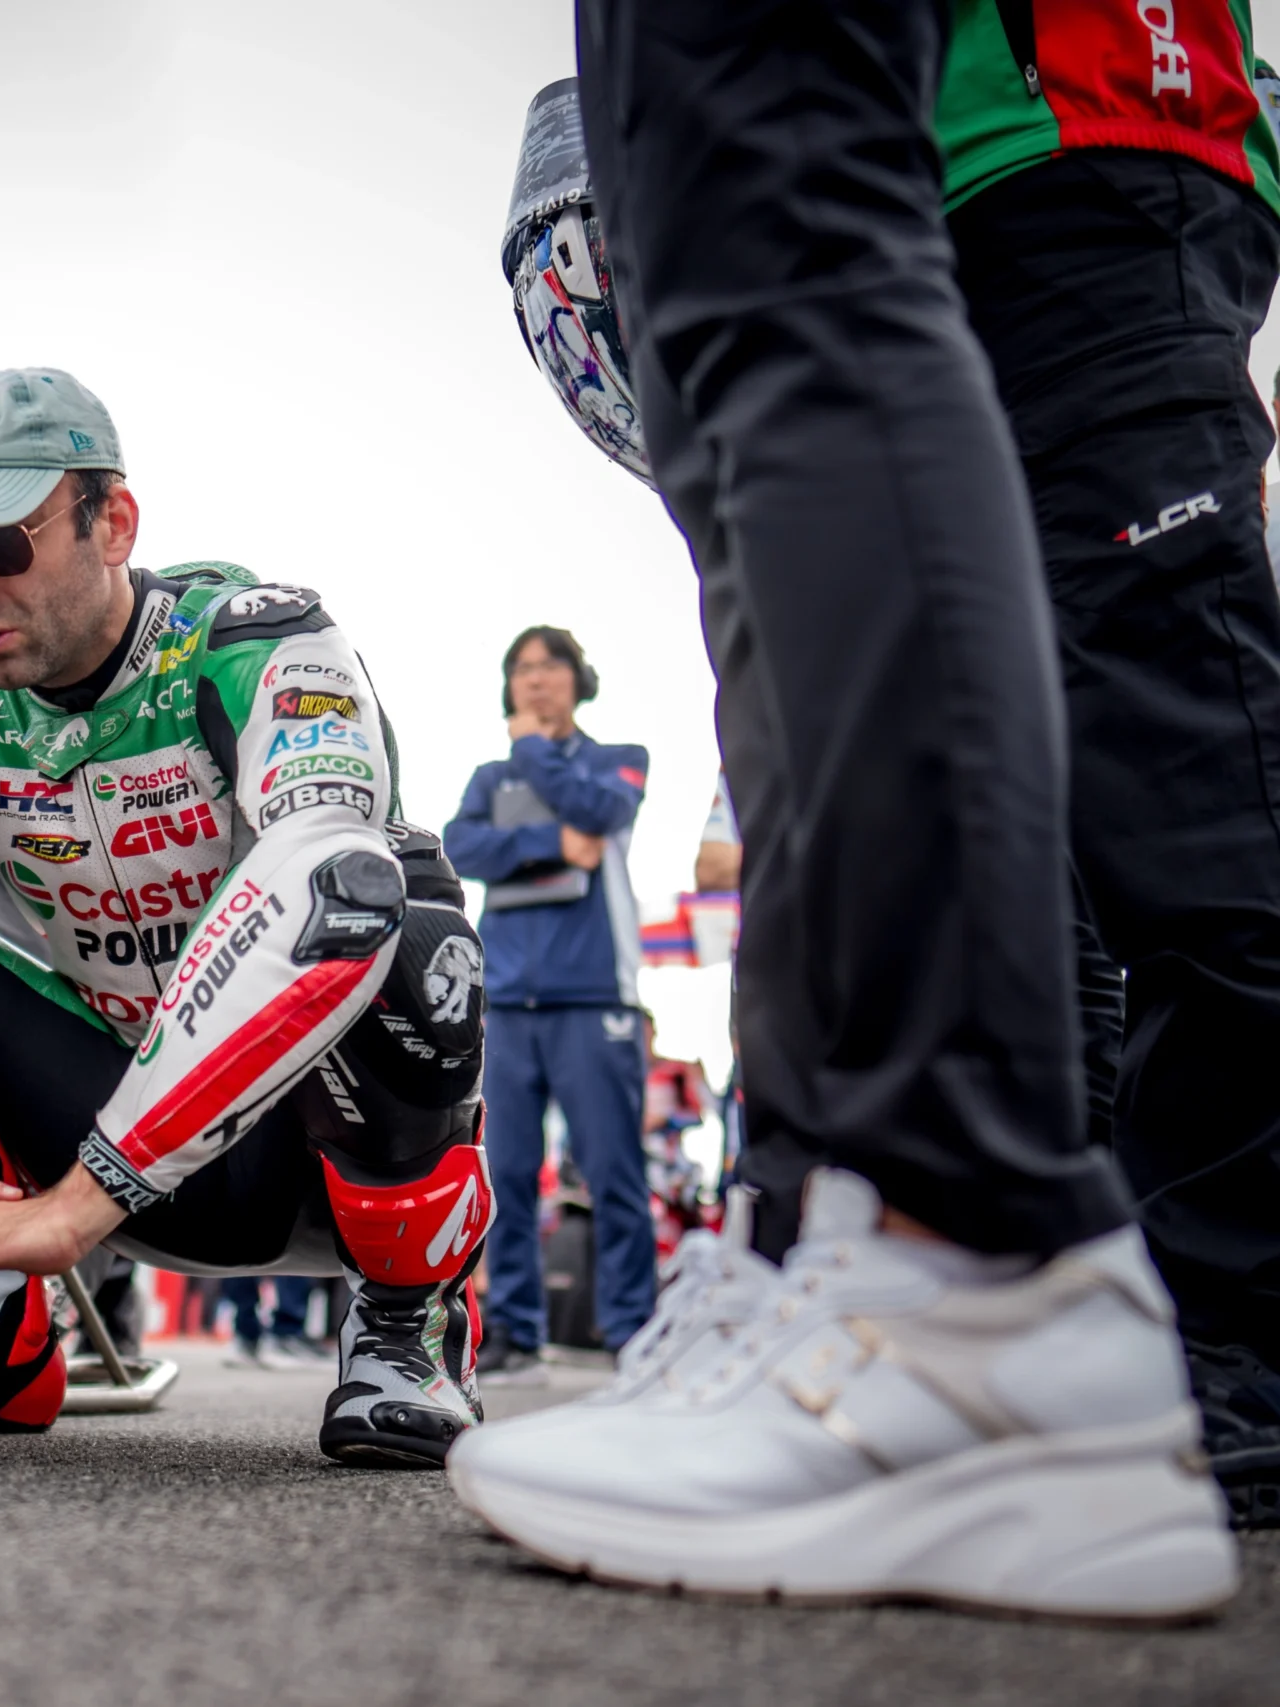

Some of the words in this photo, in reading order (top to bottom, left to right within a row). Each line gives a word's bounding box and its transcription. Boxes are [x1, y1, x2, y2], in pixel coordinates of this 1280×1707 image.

[1127, 489, 1223, 546] LCR
[120, 761, 188, 796] Castrol
[276, 756, 367, 785] DRACO
[293, 784, 372, 818] Beta
[110, 802, 219, 858] GIVI
[58, 864, 228, 922] Castr
[74, 921, 188, 967] POW
[161, 879, 263, 1012] Castrol
[176, 893, 286, 1038] POWER1
